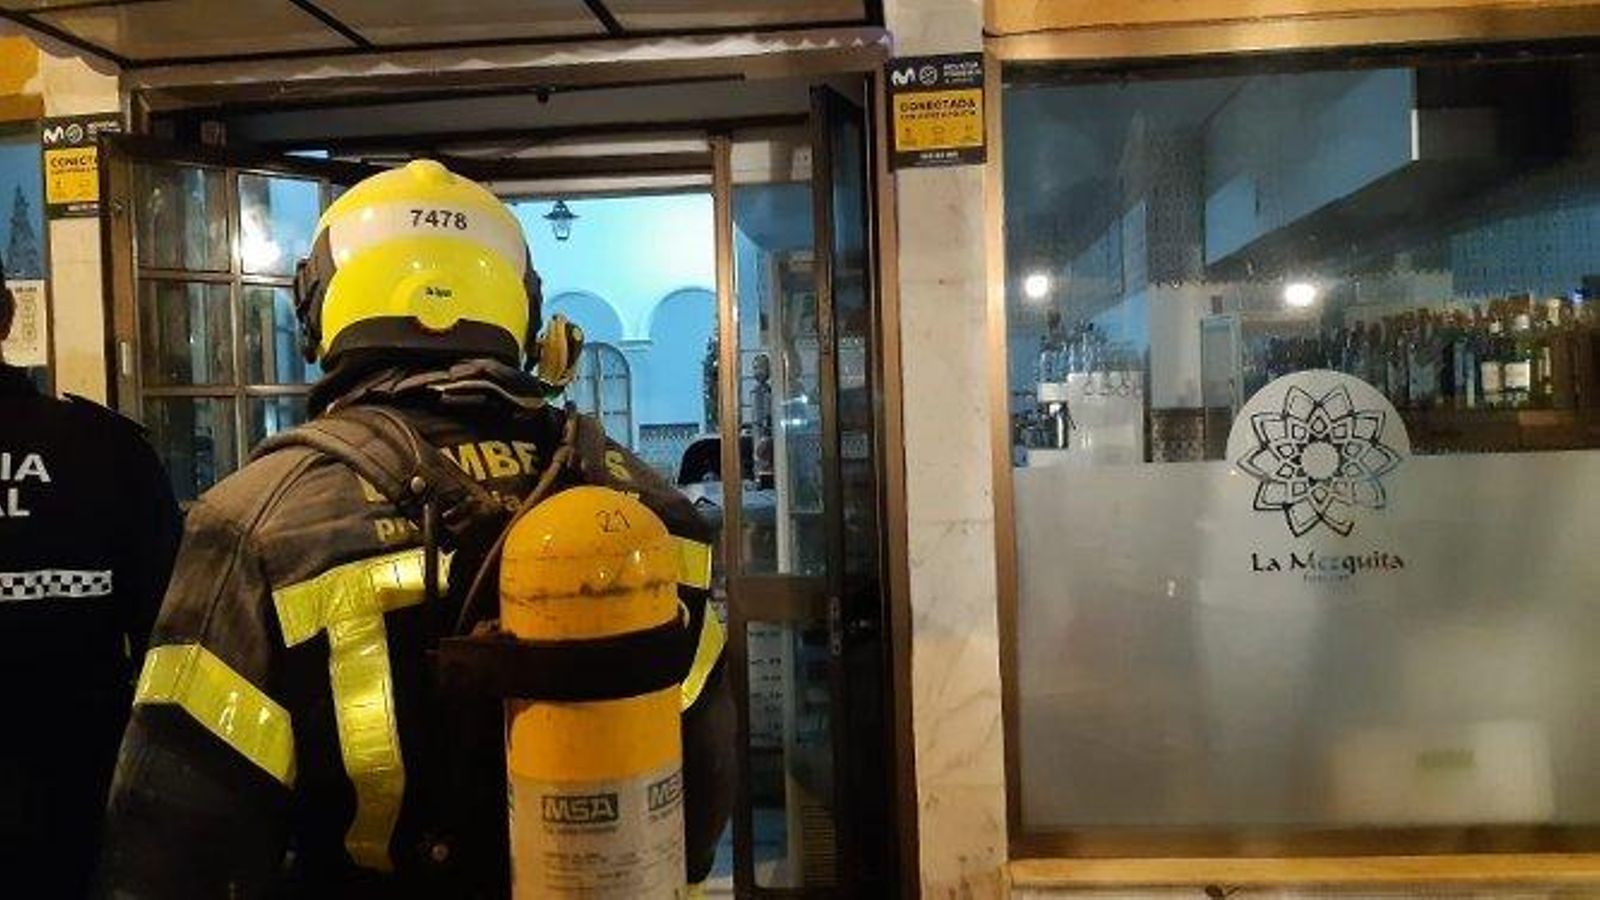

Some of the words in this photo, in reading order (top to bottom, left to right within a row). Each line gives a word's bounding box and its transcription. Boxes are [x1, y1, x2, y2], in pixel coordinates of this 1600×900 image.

[410, 208, 468, 231] 7478
[1251, 552, 1281, 573] La
[1290, 550, 1405, 574] Mezquita
[545, 797, 616, 821] MSA
